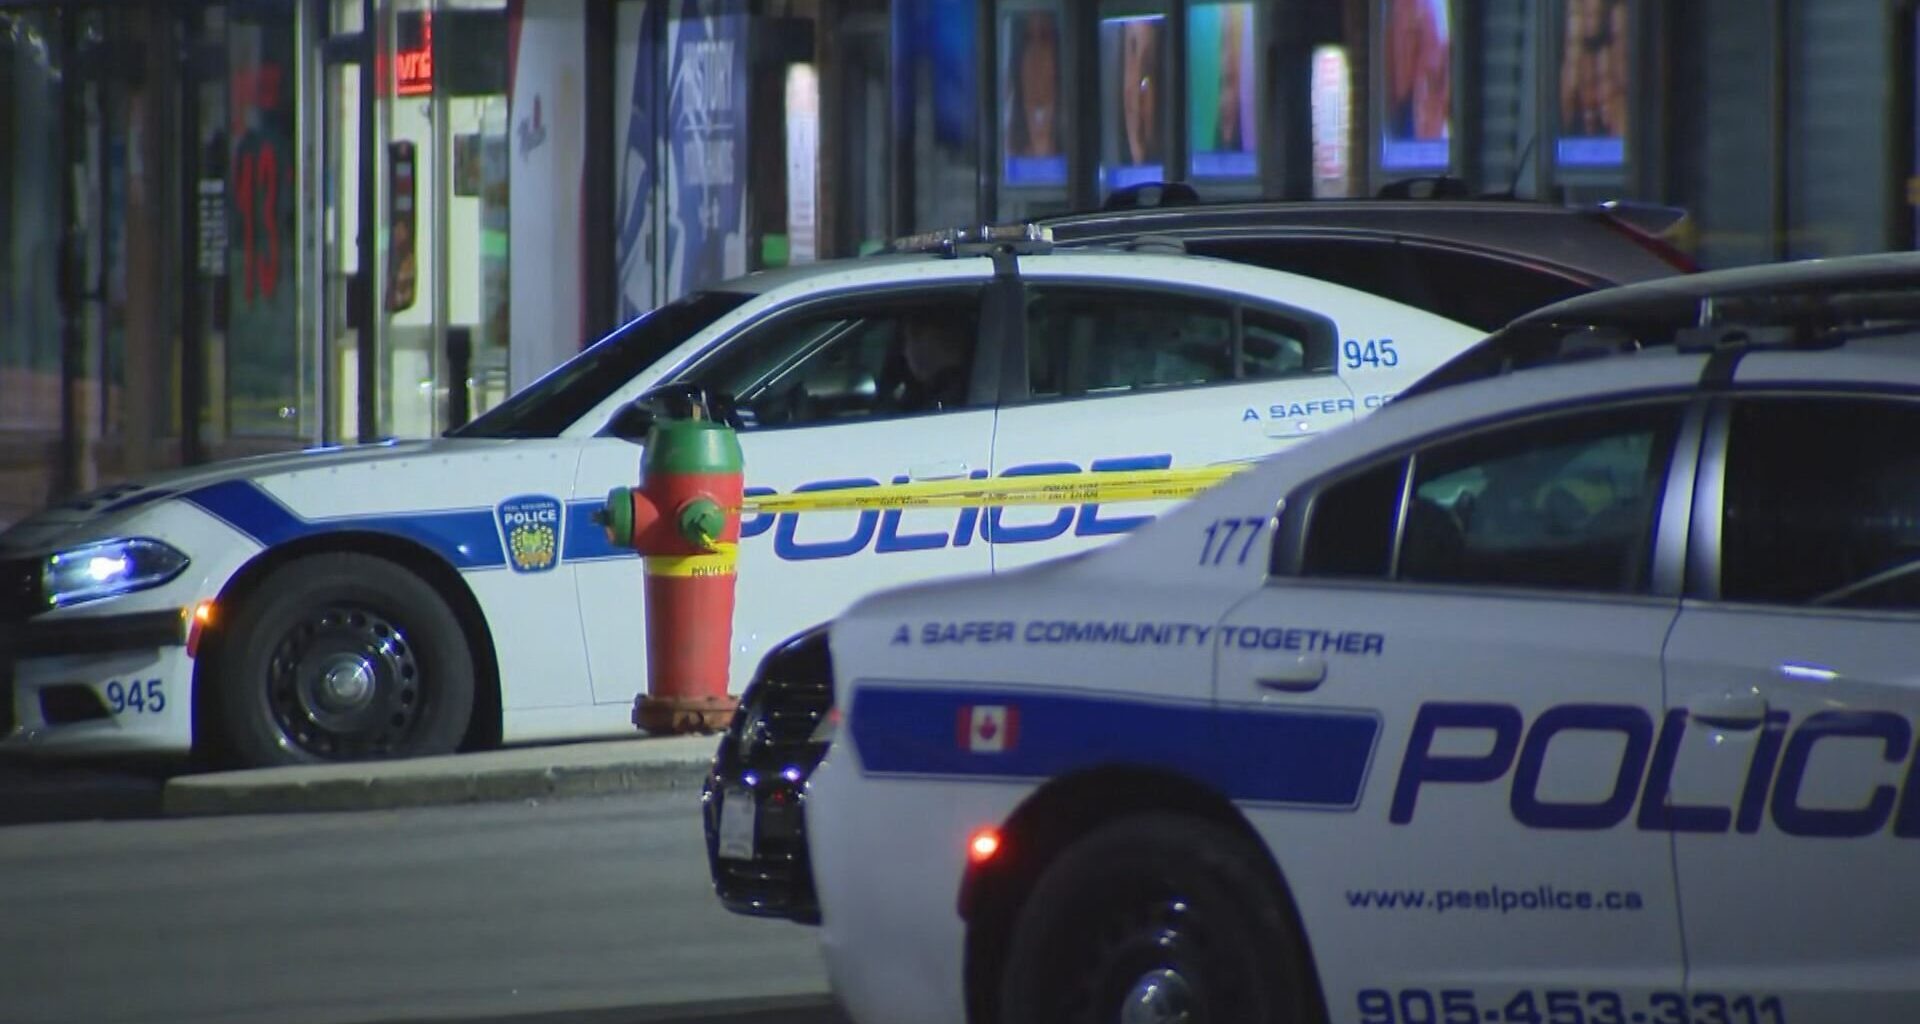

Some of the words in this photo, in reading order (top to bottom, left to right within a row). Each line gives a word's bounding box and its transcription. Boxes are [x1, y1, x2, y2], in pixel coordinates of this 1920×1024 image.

[1344, 339, 1399, 369] 945
[1243, 408, 1260, 422] A
[1269, 399, 1355, 419] SAFER
[504, 509, 555, 525] POLICE
[1199, 518, 1266, 567] 177
[890, 624, 912, 646] A
[921, 621, 1015, 645] SAFER
[1025, 621, 1214, 648] COMMUNITY
[1219, 626, 1385, 655] TOGETHER
[107, 679, 166, 713] 945
[1389, 701, 1920, 839] POLIC
[1346, 885, 1644, 914] www.peelpolice.ca
[1356, 988, 1786, 1024] 905-453-3311
